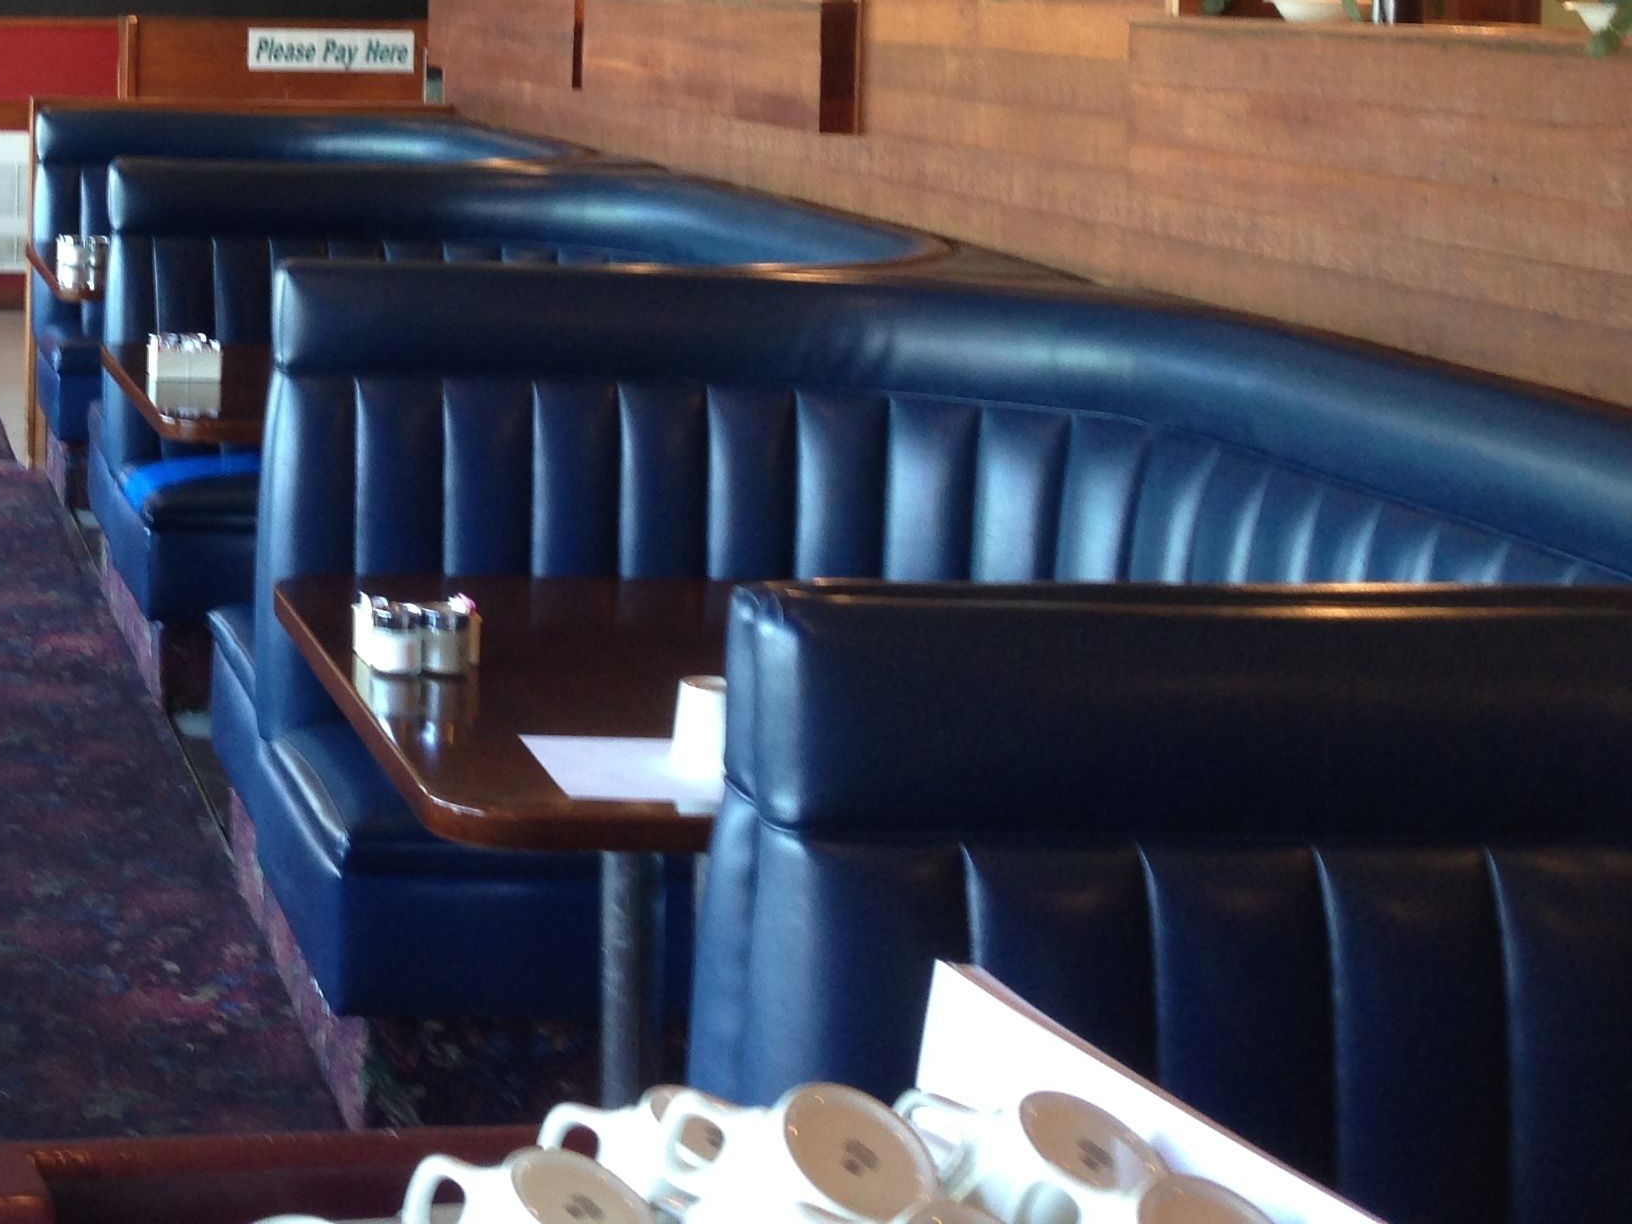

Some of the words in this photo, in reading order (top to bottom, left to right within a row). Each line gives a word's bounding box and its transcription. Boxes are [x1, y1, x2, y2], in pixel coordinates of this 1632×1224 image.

[256, 36, 317, 63] Please
[323, 38, 358, 71] Pay
[366, 38, 410, 65] Here
